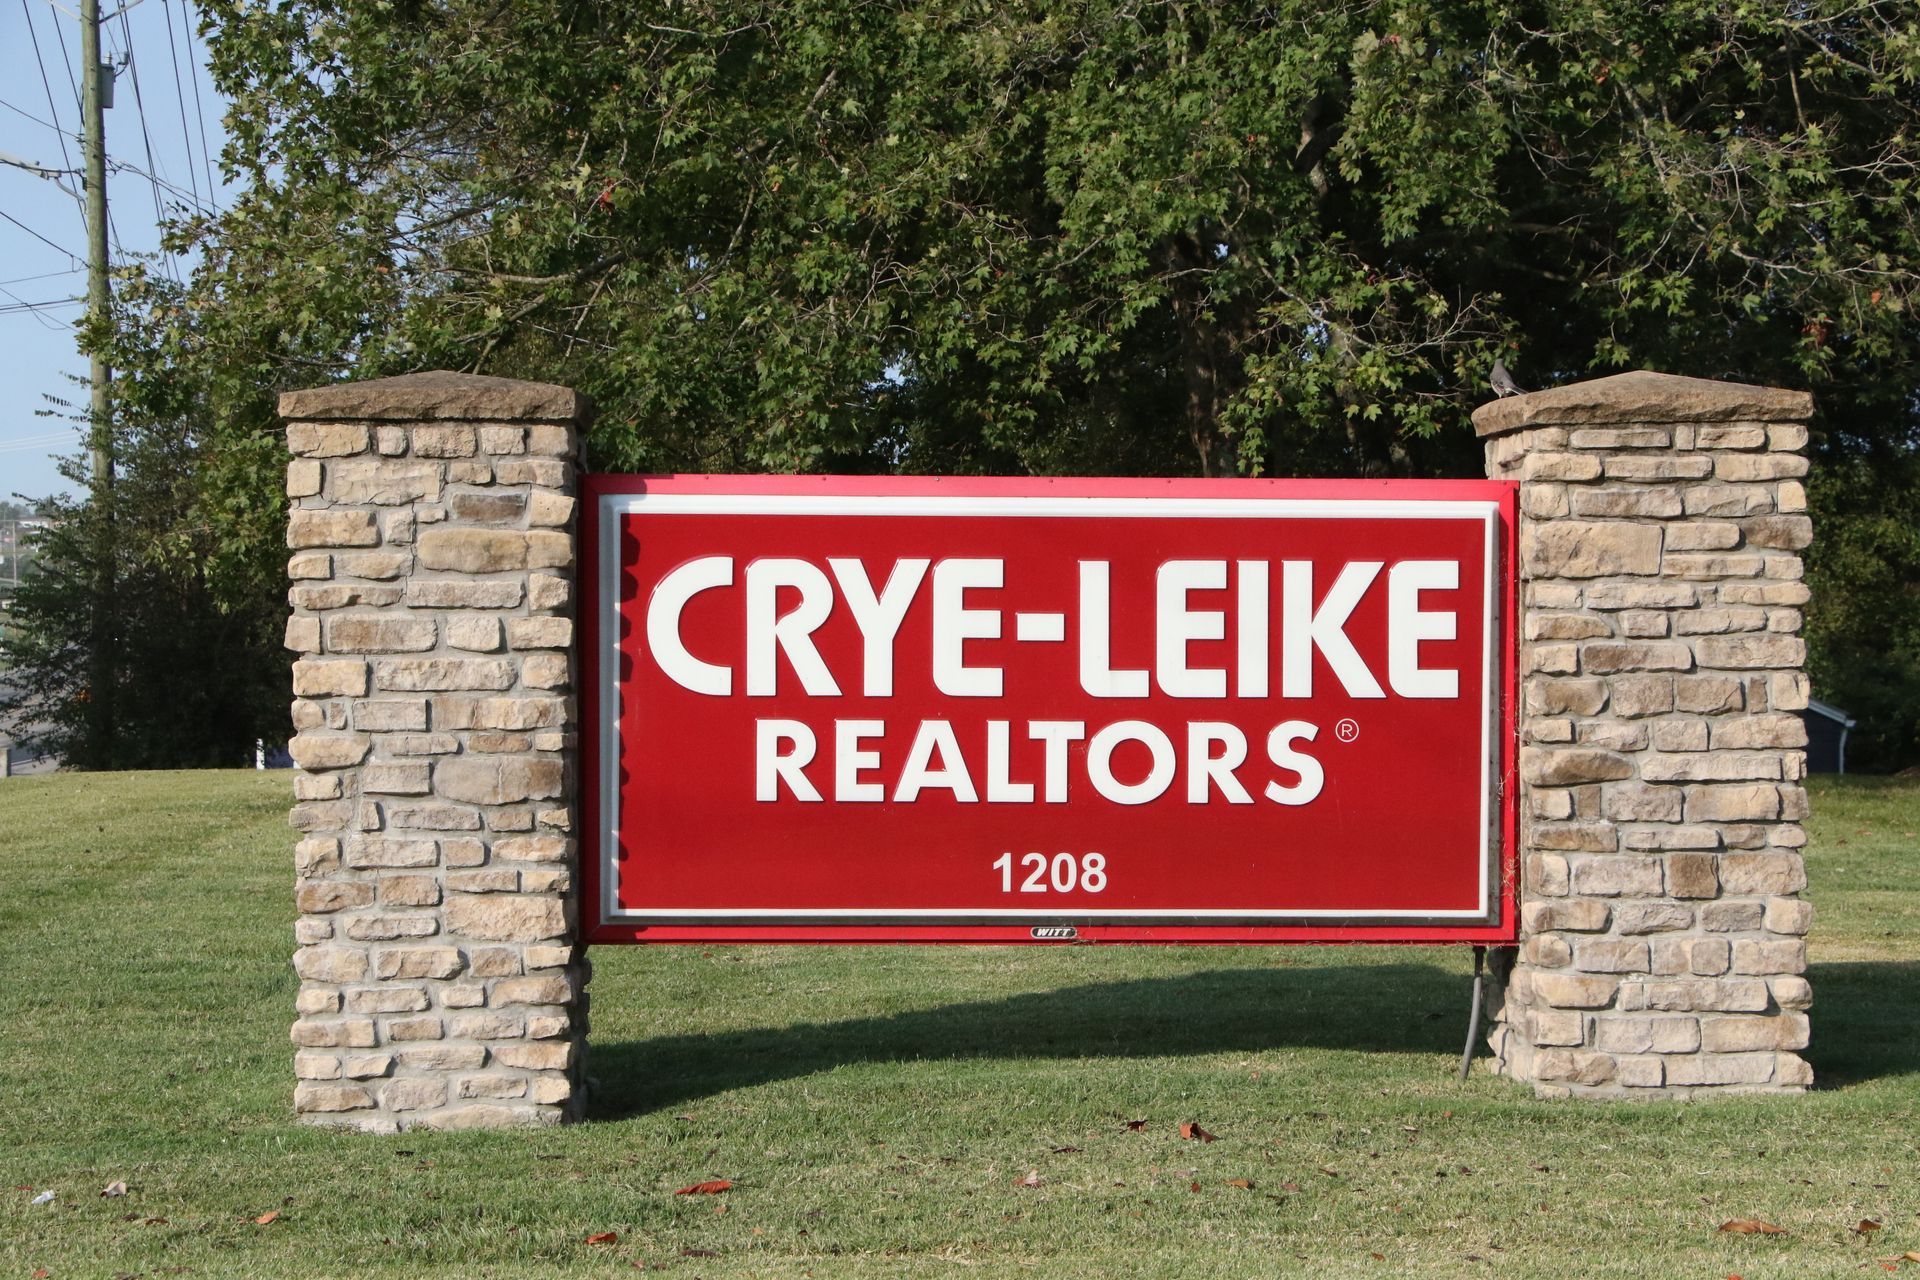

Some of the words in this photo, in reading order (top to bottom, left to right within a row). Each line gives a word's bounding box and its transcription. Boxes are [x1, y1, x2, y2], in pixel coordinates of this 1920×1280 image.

[647, 556, 1460, 699] CRYE-LEIKE
[992, 852, 1108, 893] 1208
[1036, 928, 1071, 937] WITT
